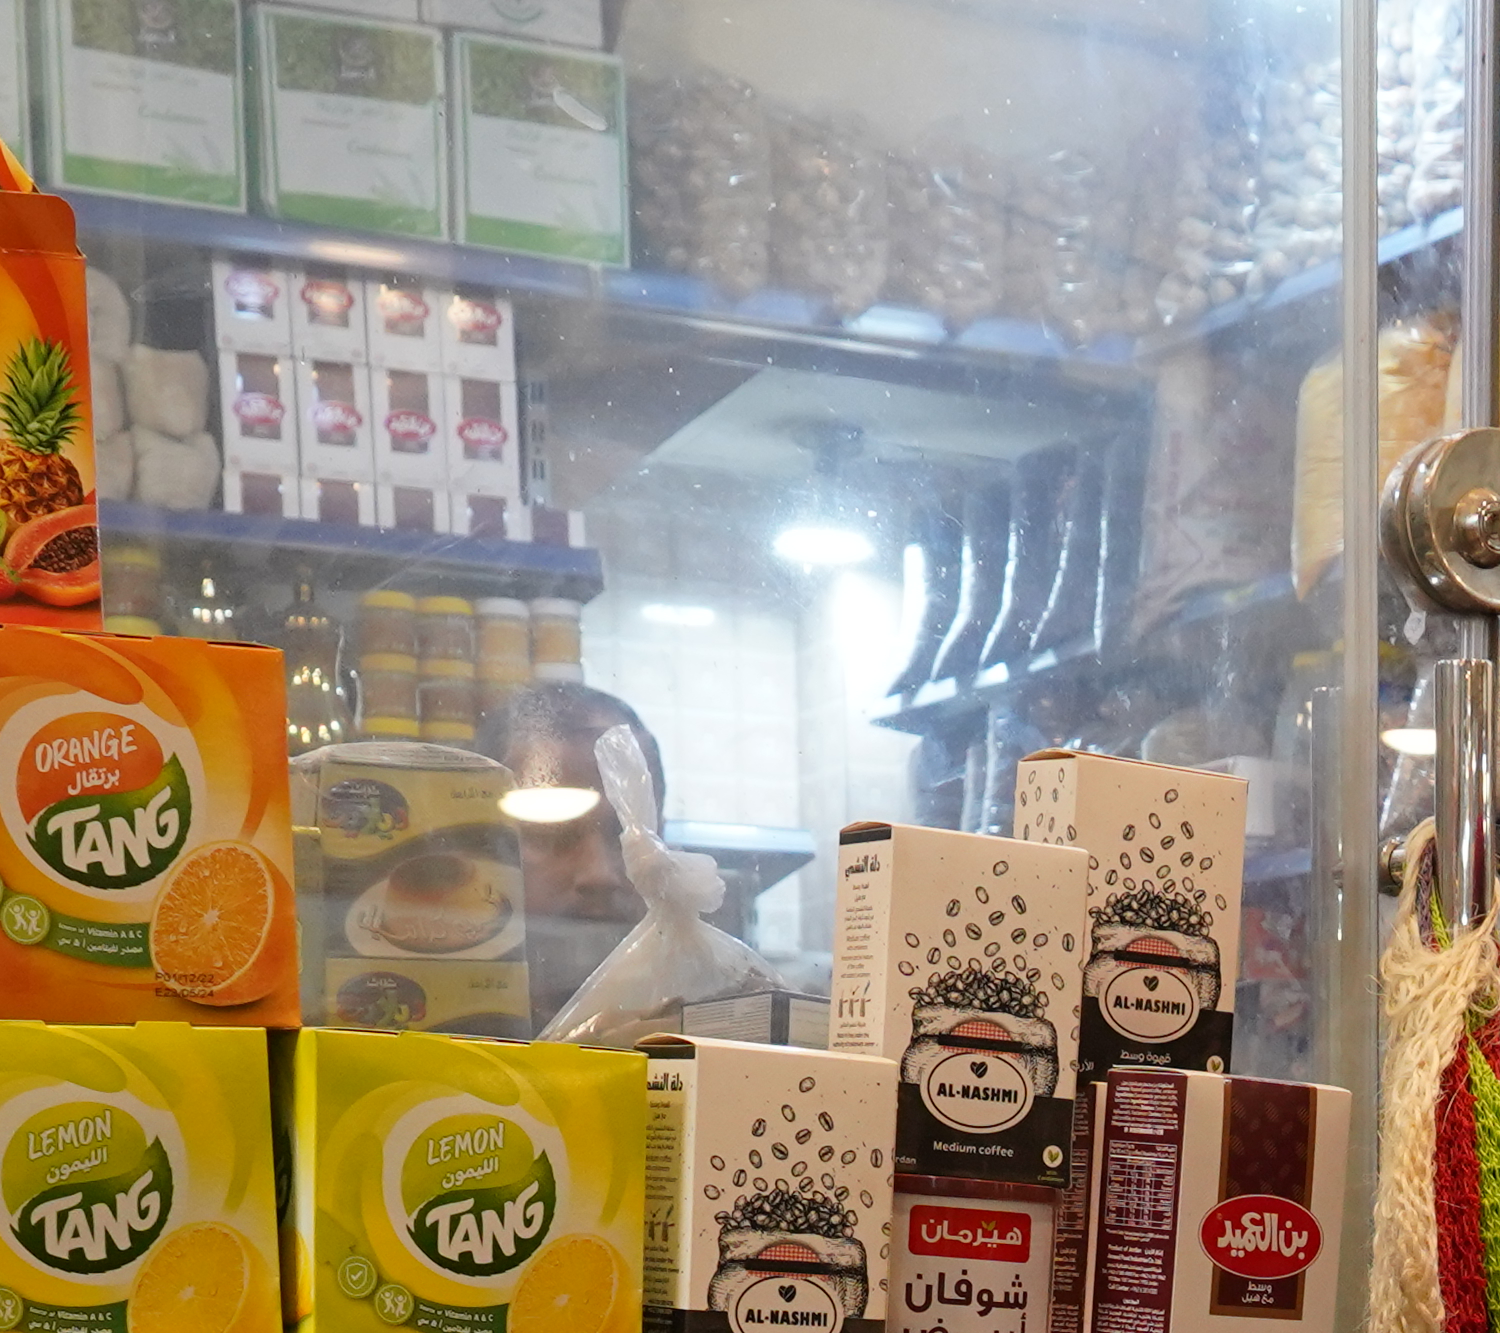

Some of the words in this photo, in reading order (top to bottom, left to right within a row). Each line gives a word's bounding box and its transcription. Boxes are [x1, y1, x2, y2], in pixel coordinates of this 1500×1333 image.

[36, 724, 137, 774] ORANGE
[67, 766, 121, 796] برتقال
[47, 786, 180, 877] TANG
[1112, 992, 1187, 1017] AL-NASHMI
[936, 1082, 1019, 1105] AL-NASHMI
[26, 1110, 112, 1161] LEMON
[426, 1123, 505, 1166] LEMON
[932, 1140, 977, 1157] Medium
[981, 1143, 1015, 1158] coffee
[45, 1144, 109, 1184] الليمون
[441, 1156, 499, 1189] الليمون
[30, 1169, 161, 1262] TANG
[426, 1181, 538, 1265] TANG
[904, 1271, 1029, 1317] شوفان
[744, 1307, 829, 1328] AL-NASHMI
